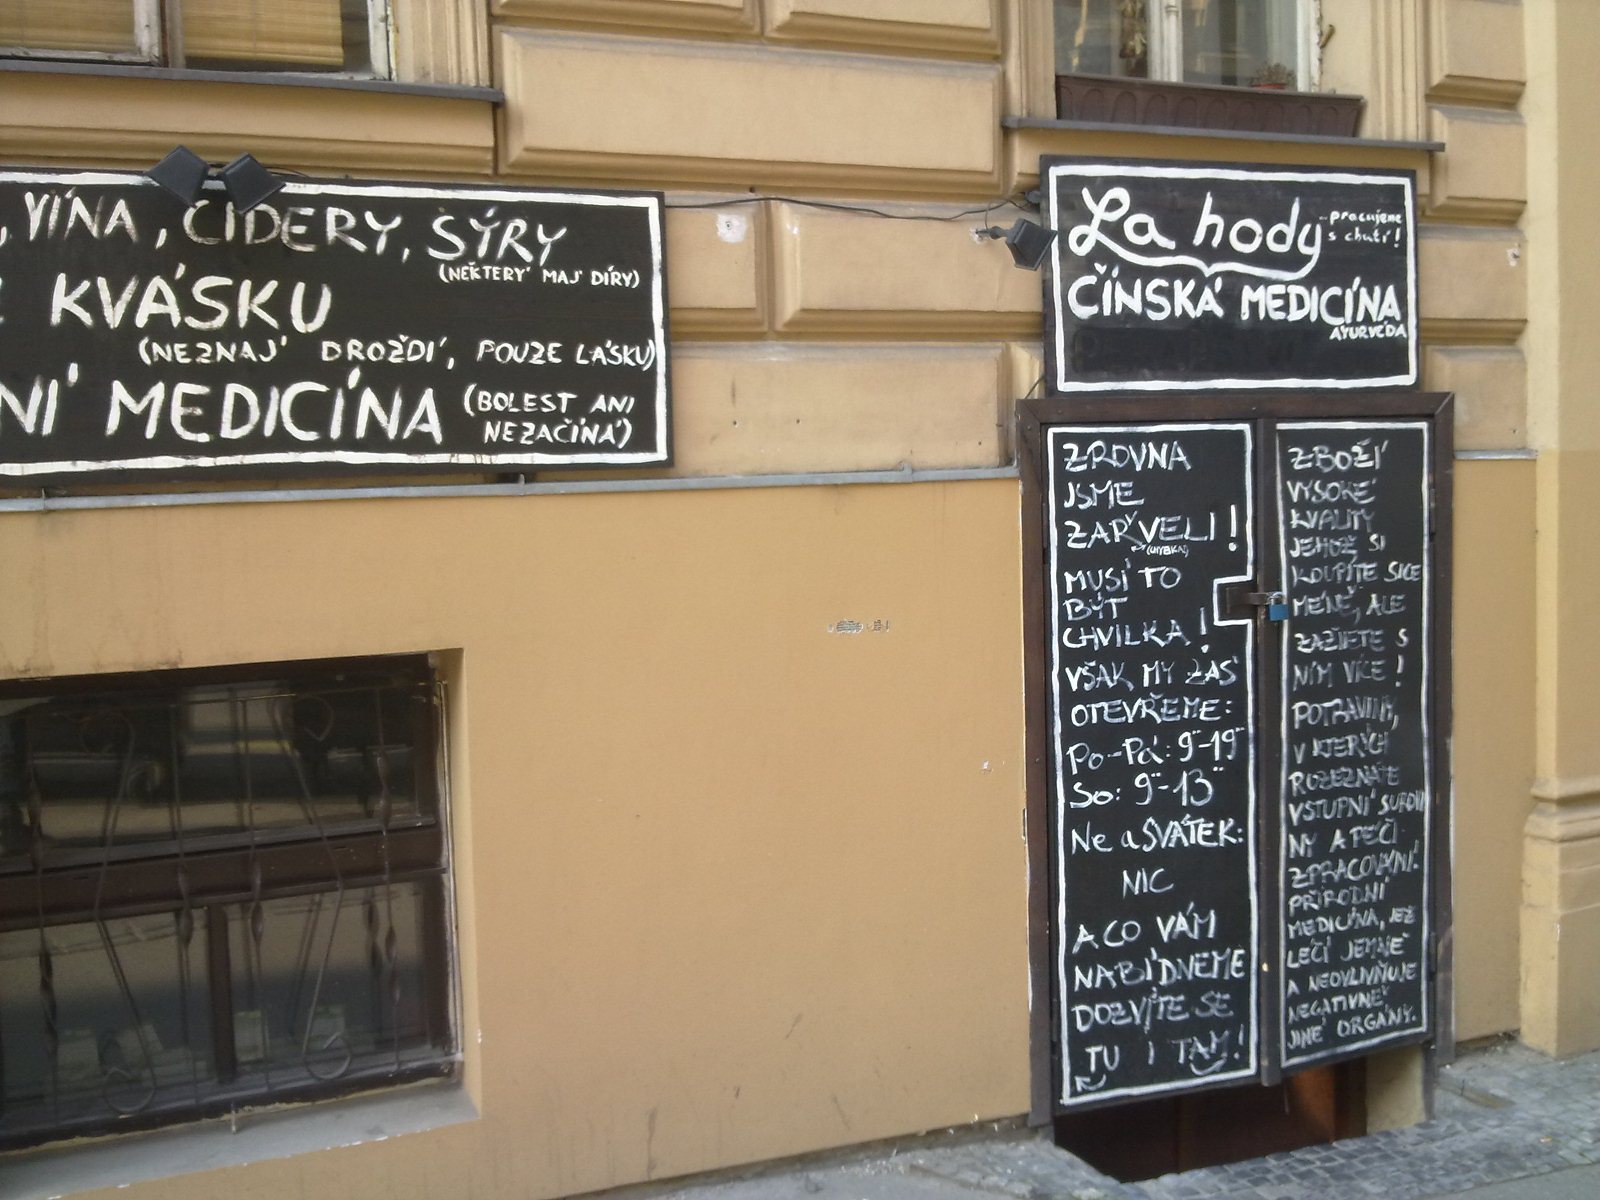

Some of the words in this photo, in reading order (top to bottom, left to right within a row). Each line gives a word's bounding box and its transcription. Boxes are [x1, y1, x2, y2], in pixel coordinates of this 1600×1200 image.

[428, 207, 567, 265] SÝRY
[1068, 187, 1176, 257] La
[1193, 191, 1322, 281] hody
[590, 265, 640, 288] DÍRY)
[51, 263, 331, 333] KVÁSKU
[1068, 263, 1224, 320] ČÍNSKÁ
[1241, 276, 1401, 325] MEDICÍNA
[321, 334, 455, 370] DROŽDÍ,
[476, 340, 563, 366] POUZE
[576, 340, 656, 371] LÁSKU)
[106, 366, 442, 444] MEDICÍNA
[464, 383, 577, 417] (BOLEST
[590, 395, 635, 415] ANI
[484, 418, 632, 449] NEZAČÍNÁ)
[1063, 440, 1192, 472] ZROVNA
[1288, 437, 1389, 473] ZBOŽÍ
[1064, 480, 1145, 509] JSME
[1290, 508, 1375, 532] KVALITY
[1064, 558, 1132, 594] MUSÍ
[1138, 566, 1181, 589] TO
[1063, 592, 1128, 621] BÝT
[1366, 593, 1406, 616] ALE
[1395, 628, 1409, 647] S
[1065, 660, 1134, 691] VŠAK
[1142, 660, 1175, 688] MY
[1071, 692, 1233, 727] OTEVŘEME:
[1071, 821, 1113, 855] Ne
[1121, 830, 1140, 850] a
[1329, 829, 1346, 853] A
[1122, 868, 1174, 899] NIC
[1072, 924, 1099, 954] A
[1103, 920, 1141, 947] CO
[1156, 901, 1216, 943] VÁM
[1074, 947, 1245, 992] NABÍDNEME
[1195, 990, 1234, 1017] SE
[1287, 979, 1300, 998] A
[1085, 1044, 1120, 1073] TU
